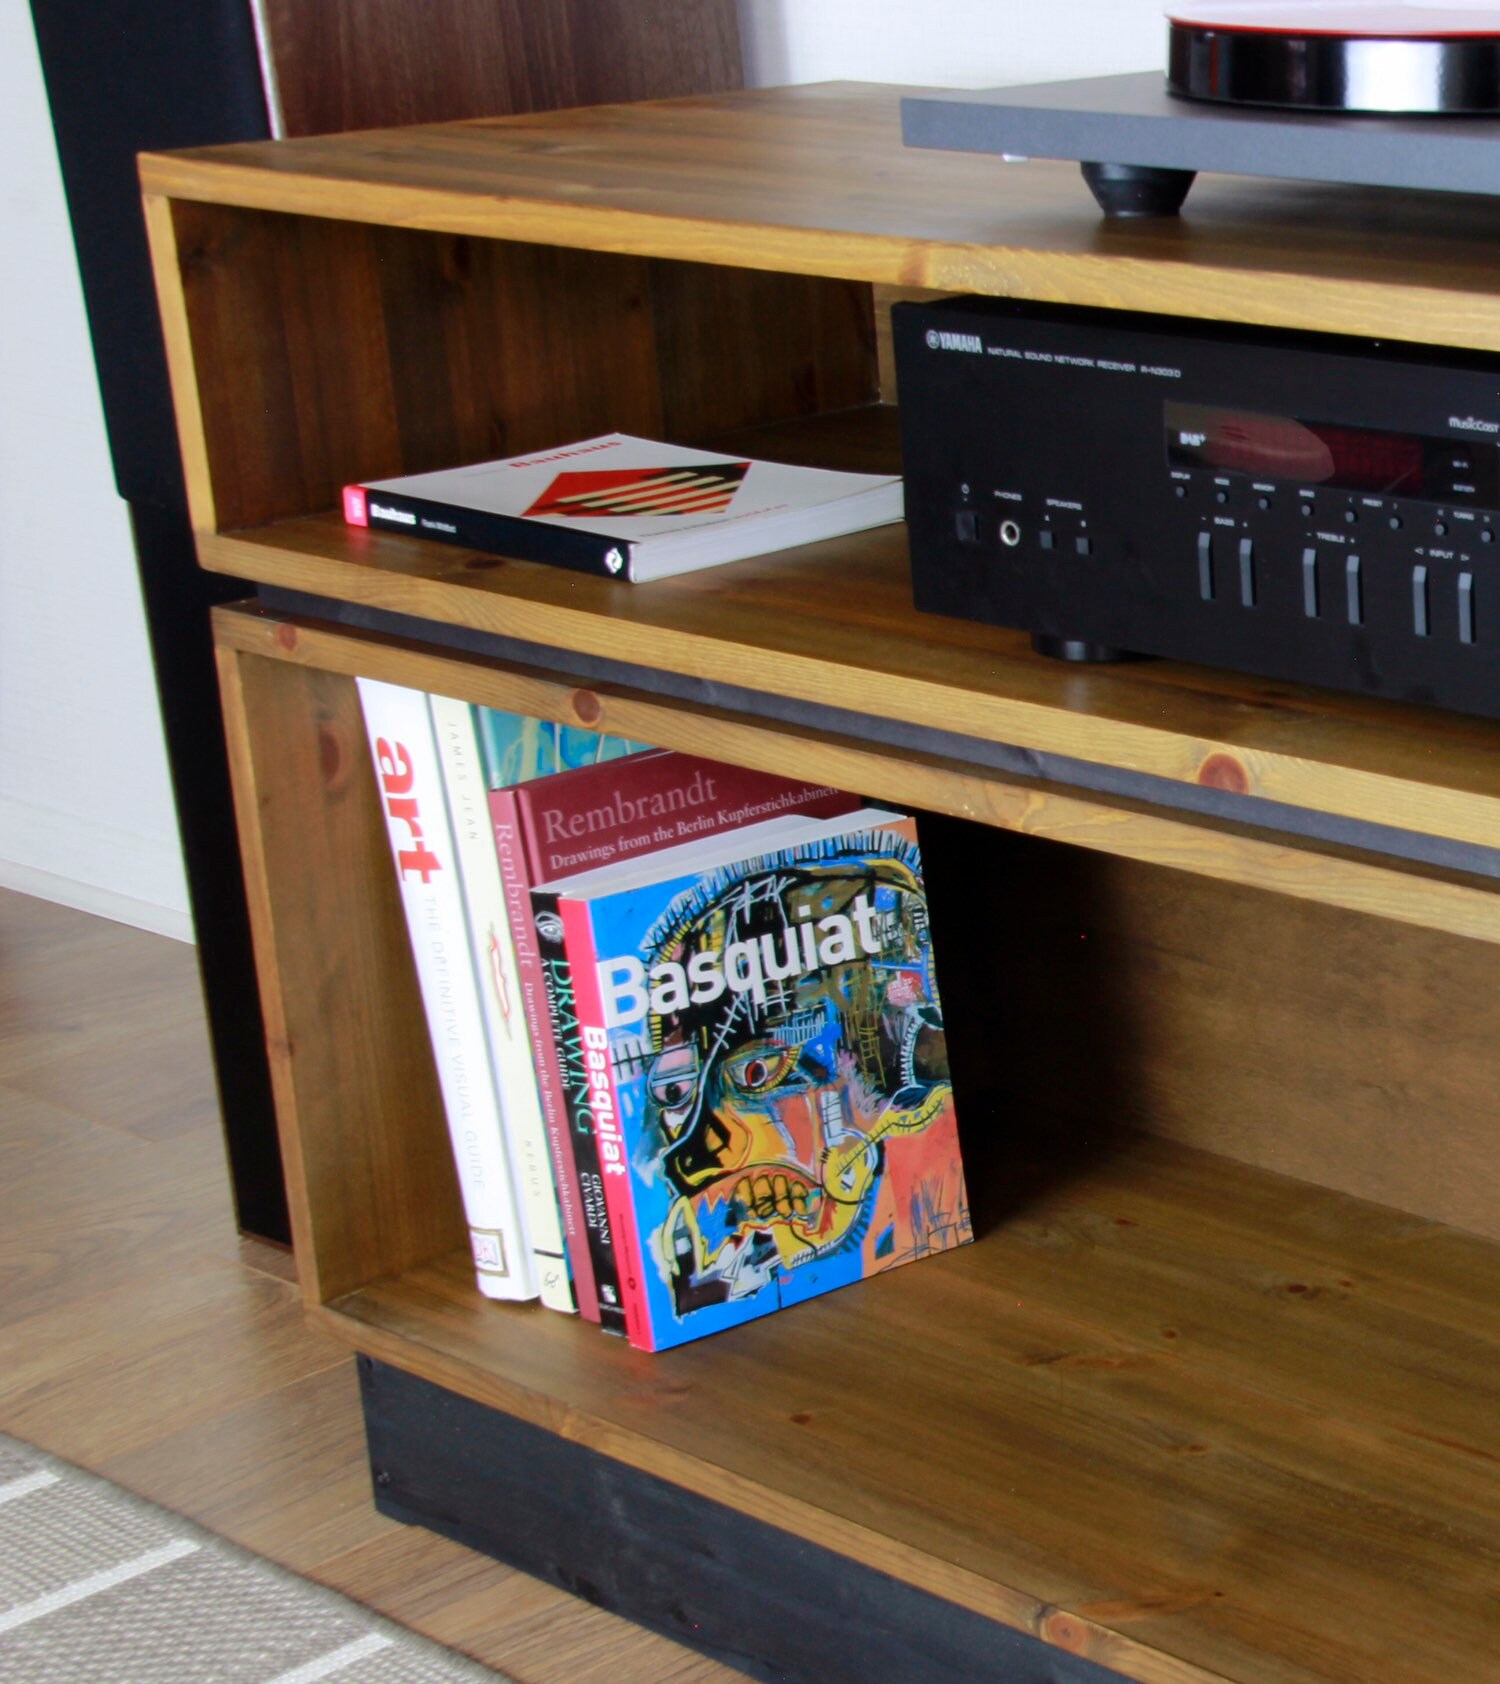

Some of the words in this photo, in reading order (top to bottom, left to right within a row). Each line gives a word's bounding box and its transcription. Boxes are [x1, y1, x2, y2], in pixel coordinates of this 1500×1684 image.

[939, 332, 982, 353] YAMAHA
[987, 347, 1022, 359] NATURAL
[1024, 351, 1052, 362] SOUND
[1054, 354, 1095, 367] NETWORK
[1097, 360, 1136, 372] RECEIVER
[1316, 532, 1345, 544] TREBLE
[1429, 548, 1455, 559] INPUT
[376, 736, 443, 884] art
[542, 770, 719, 844] Rembrandt
[550, 842, 616, 871] Drawings
[618, 834, 651, 855] from
[653, 825, 675, 842] the
[676, 815, 715, 837] Berlin
[496, 824, 536, 968] Rembrandt
[596, 893, 882, 1030] Basquiat
[525, 982, 540, 1037] Drawings
[543, 971, 563, 1042] COMPLETE
[557, 1047, 571, 1091] GUIDE
[431, 941, 461, 1045] DEFINITIVE
[451, 1053, 473, 1118] VISUAL
[463, 1130, 485, 1189] GUIDE
[536, 1039, 548, 1069] from
[551, 959, 596, 1136] DRAWING
[540, 1069, 550, 1088] the
[583, 1025, 626, 1177] Basquiat
[544, 1090, 557, 1124] Berlin
[581, 1172, 599, 1228] CIVARDI
[592, 1174, 611, 1245] GIOVANNI
